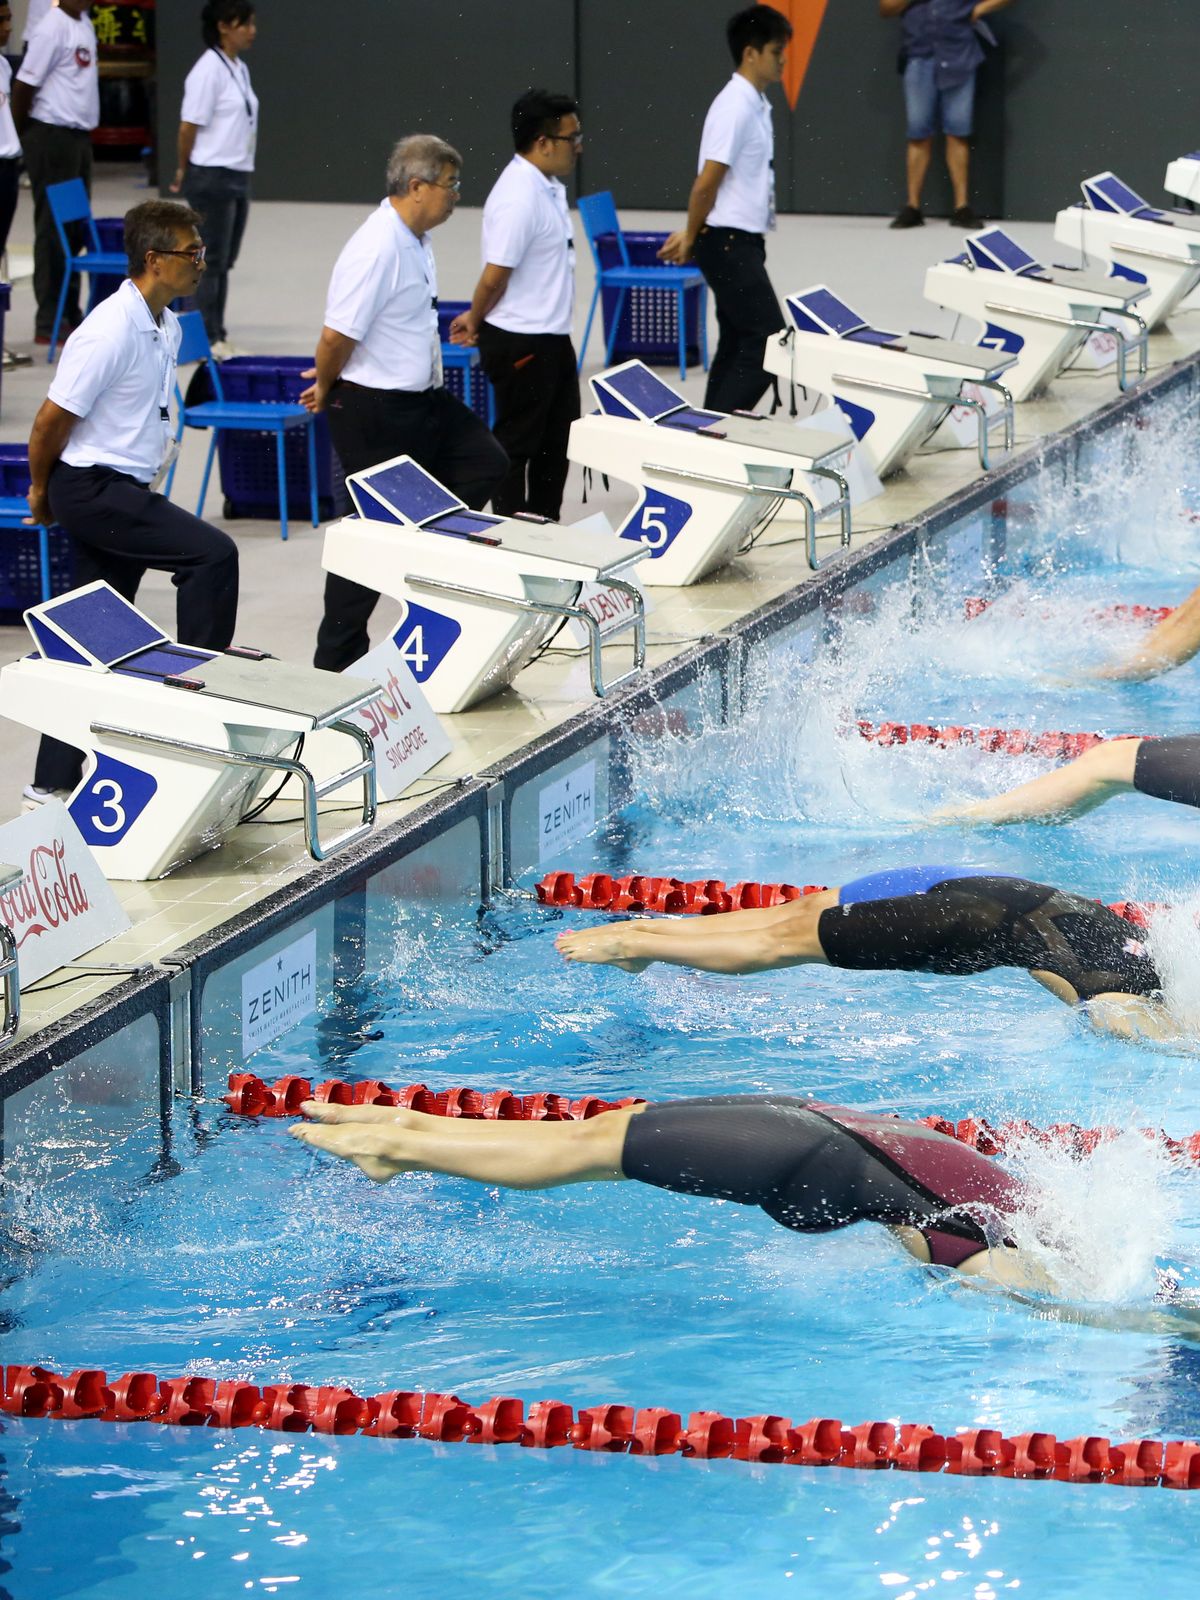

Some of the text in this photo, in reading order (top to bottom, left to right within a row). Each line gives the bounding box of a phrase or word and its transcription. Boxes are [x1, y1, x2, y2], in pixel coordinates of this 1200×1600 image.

[640, 506, 668, 549] 5
[399, 625, 429, 672] 4
[385, 725, 428, 769] SINGAPORE
[91, 779, 126, 833] 3
[544, 788, 591, 834] ZENITH
[248, 964, 311, 1024] ZENITH
